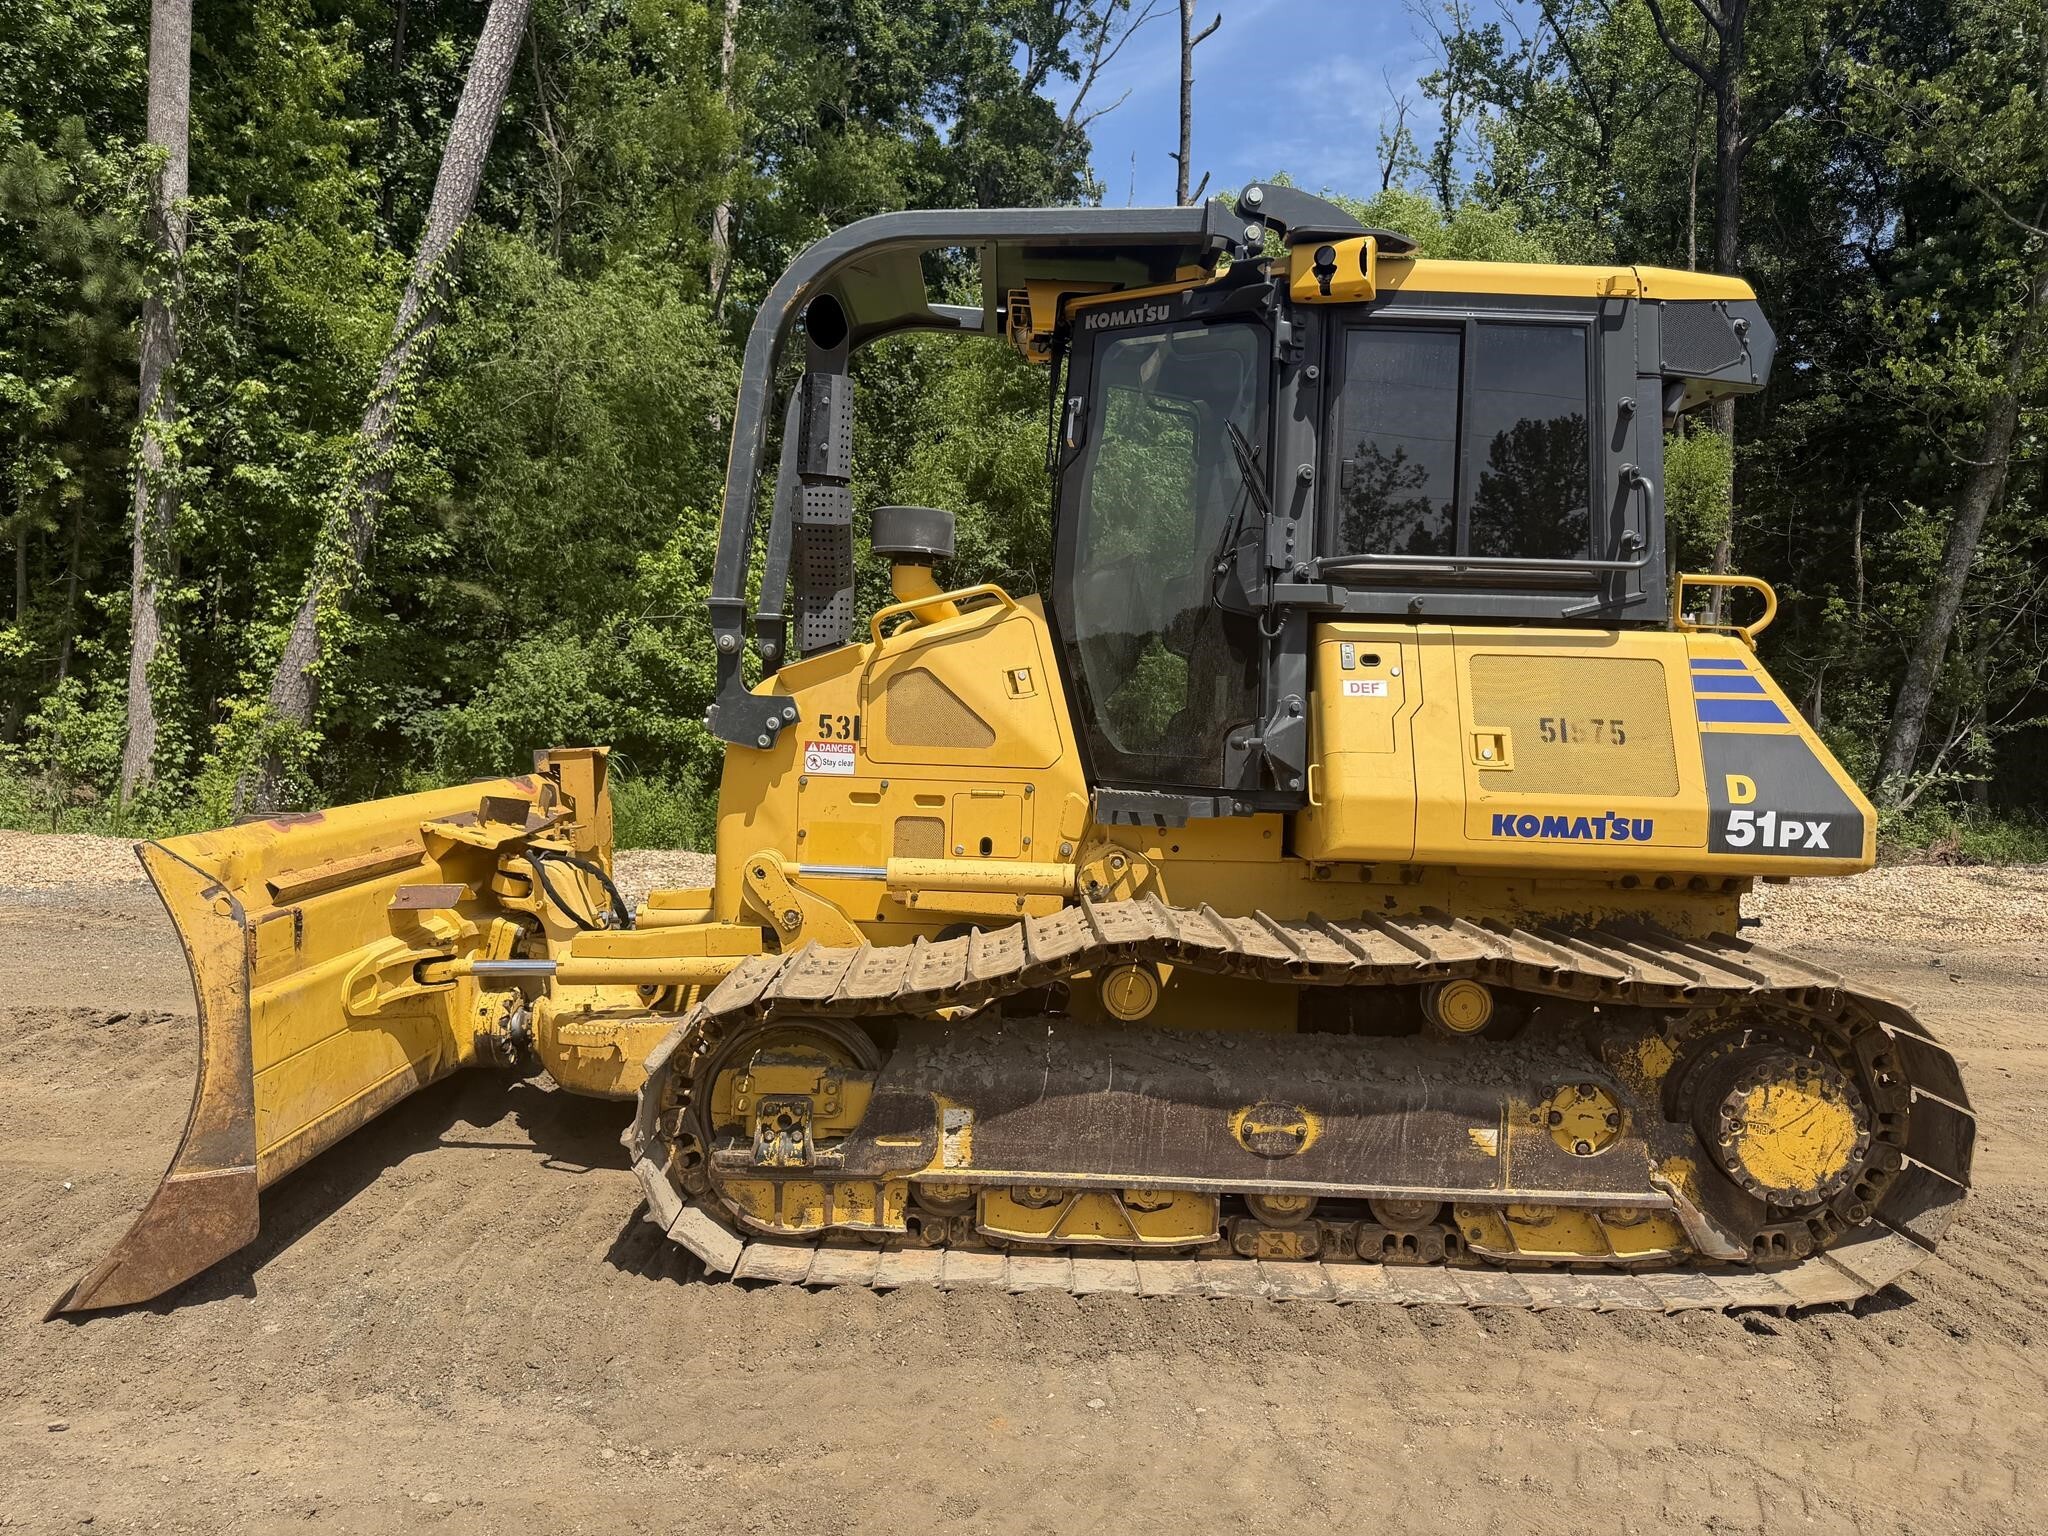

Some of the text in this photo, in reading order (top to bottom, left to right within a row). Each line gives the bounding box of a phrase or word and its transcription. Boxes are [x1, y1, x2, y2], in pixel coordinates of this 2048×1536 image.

[1085, 303, 1170, 330] KOMATSU
[1350, 682, 1380, 694] DEF
[818, 714, 860, 742] 531
[819, 743, 854, 753] DANGER
[822, 758, 854, 768] Stay clear
[1725, 774, 1757, 805] D
[1491, 811, 1654, 841] KOMATSU
[1724, 809, 1832, 849] 51PX
